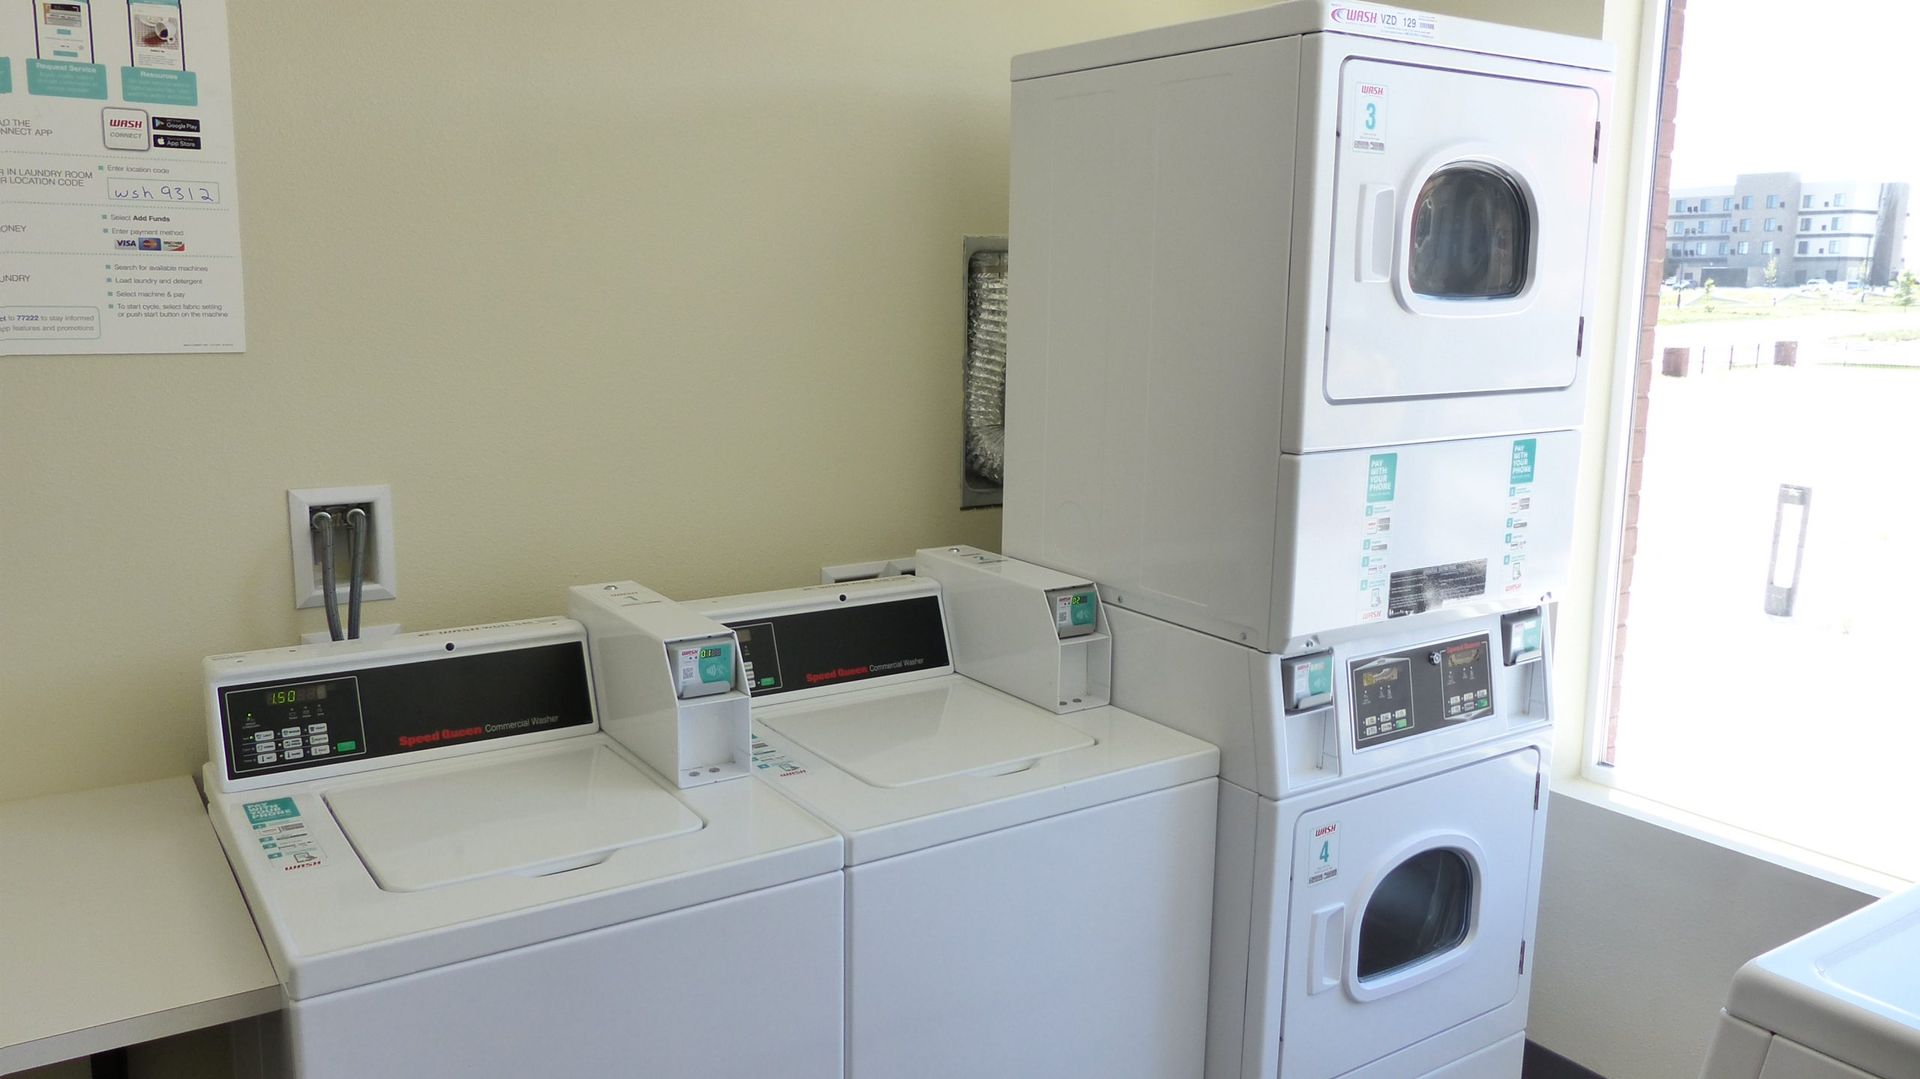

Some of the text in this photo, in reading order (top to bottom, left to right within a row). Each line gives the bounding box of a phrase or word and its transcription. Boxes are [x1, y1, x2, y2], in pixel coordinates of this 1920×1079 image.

[1346, 9, 1378, 24] WASH
[1403, 17, 1417, 28] 129
[36, 62, 97, 74] Request Service
[140, 70, 179, 81] Resources
[1361, 85, 1384, 96] WASH
[1365, 102, 1376, 130] 3
[12, 119, 31, 128] THE
[109, 119, 143, 129] WASH
[166, 121, 186, 130] Google
[186, 123, 198, 131] Play
[34, 129, 53, 137] APP
[109, 132, 143, 140] CONNECT
[166, 140, 196, 148] App Store
[7, 168, 16, 176] IN
[18, 168, 62, 178] LAUNDRY
[64, 170, 93, 179] ROOM
[107, 164, 170, 175] Enter location code
[9, 176, 56, 186] LOCATION
[57, 178, 85, 187] CODE
[114, 186, 215, 202] wsh 9312
[110, 213, 131, 221] Select
[148, 215, 171, 223] Funds
[112, 227, 185, 237] Enter payment method
[116, 239, 137, 247] VISA
[149, 264, 177, 272] available
[178, 265, 209, 273] machines
[115, 277, 133, 285] Load
[133, 278, 158, 286] laundry
[172, 278, 203, 287] detergent
[173, 292, 186, 300] pay
[16, 314, 40, 322] 77222
[48, 315, 63, 323] stay
[126, 311, 143, 320] push
[201, 311, 229, 319] machine
[56, 325, 95, 333] promotions
[1514, 445, 1525, 453] PAY
[1513, 451, 1529, 460] WITH
[1371, 459, 1384, 468] PAY
[1513, 458, 1529, 467] YOUR
[1370, 467, 1388, 476] WITH
[1512, 465, 1532, 475] PHONE
[1370, 475, 1388, 484] YOUR
[1369, 482, 1392, 492] PHONE
[806, 656, 924, 683] Speed Queen Commercial Washer
[399, 714, 559, 747] Speed Queen Commercial Washer
[1315, 823, 1337, 838] WASH
[1319, 840, 1330, 863] 4
